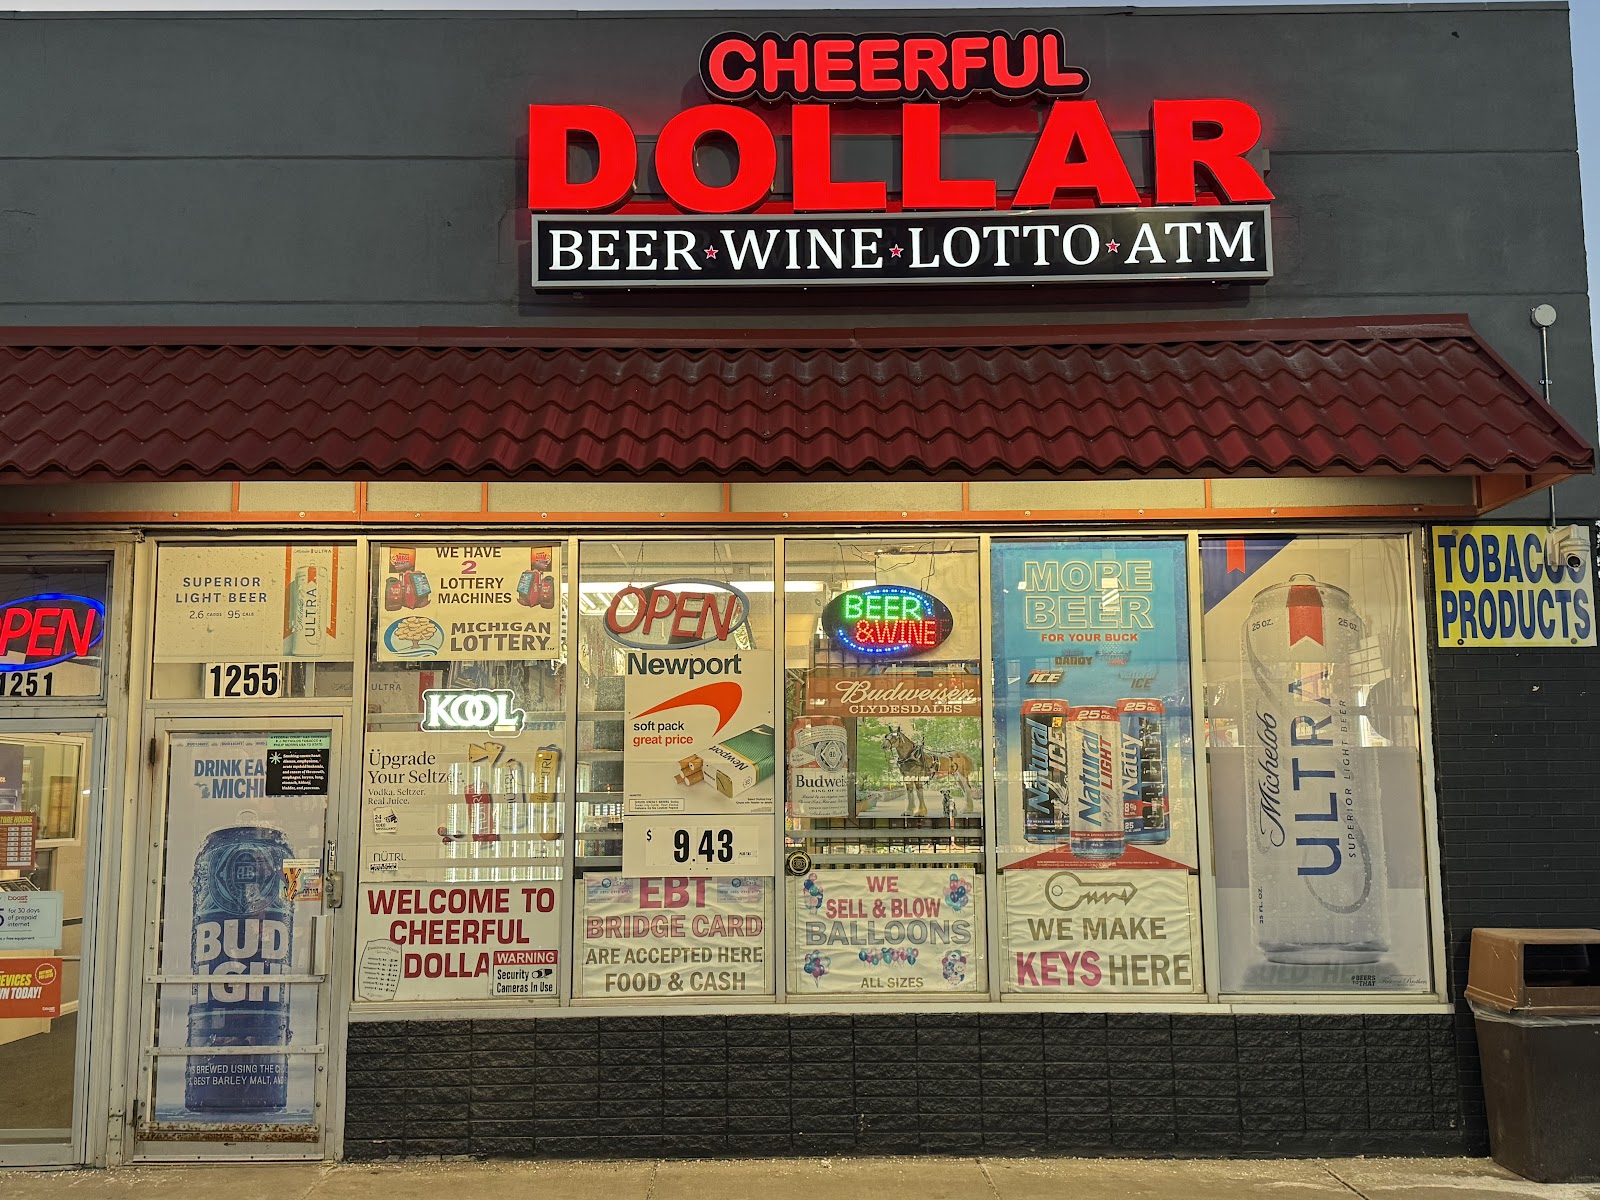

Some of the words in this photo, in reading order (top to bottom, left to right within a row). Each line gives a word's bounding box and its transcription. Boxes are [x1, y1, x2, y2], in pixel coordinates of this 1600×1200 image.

[708, 35, 1085, 92] CHEERFUL
[528, 100, 1274, 212] DOLLAR
[549, 227, 702, 271] BEER
[720, 226, 884, 271] WINE
[908, 223, 1102, 269] LOTTO
[1123, 221, 1255, 265] ATM
[435, 546, 459, 558] WE
[464, 546, 502, 558] HAVE
[461, 560, 477, 575] 2
[1025, 560, 1153, 592] MORE
[183, 577, 261, 587] SUPERIOR
[440, 577, 504, 590] LOTTERY
[175, 592, 222, 603] LIGHT
[228, 592, 268, 603] BEER
[438, 592, 512, 604] MACHINES
[845, 594, 923, 620] BEER
[189, 610, 204, 619] 2.6
[227, 610, 241, 619] 95
[305, 588, 317, 638] ULTRA
[606, 586, 737, 642] OPEN
[1025, 596, 1154, 630] BEER
[1337, 618, 1349, 628] 25
[1441, 588, 1591, 640] PRODUCTS
[0, 607, 97, 657] PEN
[451, 622, 551, 635] MICHIGAN
[1041, 633, 1064, 643] FOR
[1068, 633, 1101, 643] YOUR
[1105, 633, 1138, 643] BUCK
[1252, 622, 1262, 632] 25
[451, 634, 551, 652] LOTTERY
[627, 652, 742, 680] Newport
[0, 672, 53, 696] 1251
[210, 663, 280, 697] 1255
[371, 683, 402, 691] ULTRA
[1029, 673, 1062, 684] ICE
[835, 680, 975, 705] Budweiser
[427, 694, 520, 727] KOOL
[848, 704, 963, 714] CLYDESDALES
[1030, 702, 1053, 712] 25
[1077, 710, 1101, 720] 25
[1123, 702, 1147, 712] 25
[1339, 699, 1348, 733] BEER
[633, 720, 655, 731] soft
[657, 720, 685, 733] pack
[633, 734, 663, 747] great
[664, 734, 694, 747] price
[1048, 726, 1067, 774] ICE
[193, 759, 243, 777] DRINK
[244, 759, 266, 777] EA
[708, 745, 749, 771] Newport
[1026, 717, 1050, 815] Natural
[1100, 734, 1113, 790] LIGHT
[1123, 733, 1144, 797] Natty
[1341, 739, 1352, 780] LIGHT
[367, 770, 406, 784] Your
[1076, 725, 1102, 827] Natural
[1256, 709, 1286, 848] Michelob
[1288, 671, 1342, 876] ULTRA
[211, 778, 266, 798] MICHI
[368, 788, 396, 797] Vodka.
[368, 796, 385, 805] Real
[386, 796, 411, 805] Juice.
[0, 816, 14, 825] TORE
[1344, 788, 1357, 859] SUPERIOR
[646, 828, 652, 842] $
[674, 828, 734, 863] 9.43
[639, 877, 713, 909] EBT
[866, 875, 899, 892] WE
[367, 888, 510, 915] WELCOME
[521, 888, 555, 913] TO
[825, 897, 868, 919] SELL
[872, 897, 887, 919] &
[890, 897, 942, 918] BLOW
[390, 919, 530, 945] CHEERFUL
[586, 914, 686, 939] BRIDGE
[691, 914, 763, 938] CARD
[805, 919, 972, 946] BALLOONS
[1027, 917, 1074, 941] WE
[1083, 917, 1167, 941] MAKE
[196, 918, 289, 963] BUD
[404, 952, 489, 979] DOLLA
[496, 952, 555, 964] WARNING
[585, 948, 621, 965] ARE
[624, 947, 713, 964] ACCEPTED
[717, 946, 763, 963] HERE
[496, 968, 530, 982] Security
[1016, 950, 1102, 987] KEYS
[1108, 953, 1192, 987] HERE
[11, 986, 43, 999] TODAY!
[190, 961, 291, 1004] IGH
[496, 982, 529, 994] Cameras
[530, 982, 538, 993] In
[540, 981, 554, 993] Use
[605, 972, 662, 993] FOOD
[667, 971, 684, 992] &
[690, 971, 746, 992] CASH
[860, 977, 884, 989] ALL
[887, 976, 924, 989] SIZES
[193, 1075, 210, 1085] BEST
[212, 1075, 248, 1085] BARLEY
[249, 1075, 272, 1086] MALT,
[196, 1064, 229, 1075] BREWED
[230, 1064, 258, 1074] USING
[259, 1064, 274, 1074] THE
